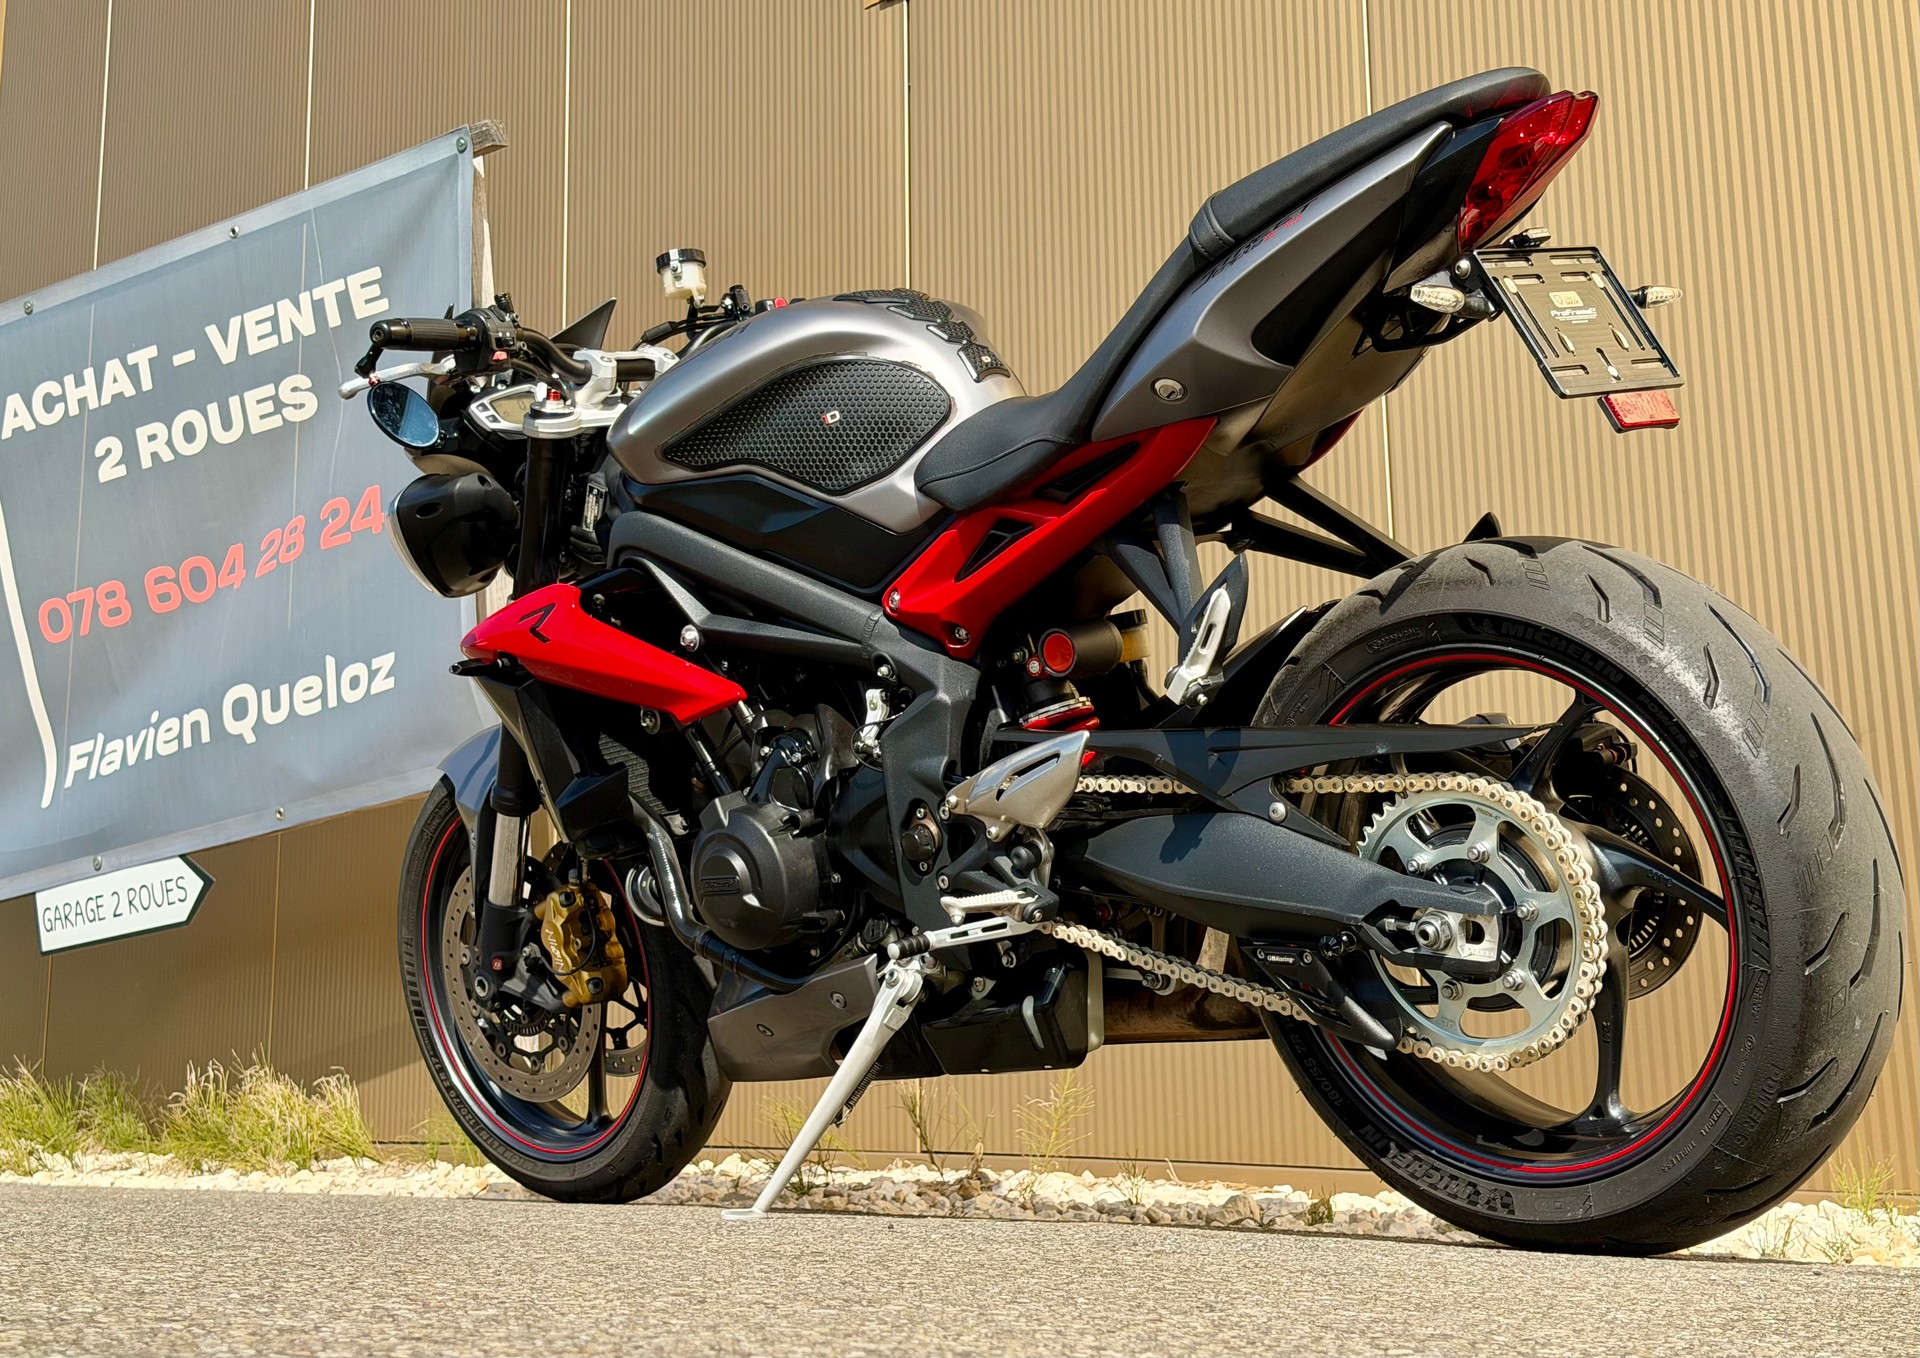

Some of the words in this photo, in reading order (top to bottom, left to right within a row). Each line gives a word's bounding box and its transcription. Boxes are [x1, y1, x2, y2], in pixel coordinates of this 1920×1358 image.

[1, 345, 158, 440] ACHAT
[204, 266, 389, 366] VENTE
[94, 436, 127, 483] 2
[135, 374, 319, 469] ROUES
[37, 579, 132, 644] 078
[144, 543, 245, 614] 604
[255, 515, 306, 578] 28
[319, 485, 385, 550] 24
[1500, 621, 1624, 684] MICHELIN
[1566, 611, 1636, 653] POWER
[64, 708, 211, 789] Flavien
[222, 651, 395, 744] Queloz
[1637, 693, 1688, 744] POWER
[42, 895, 106, 932] GARAGE
[111, 891, 124, 918] 2
[127, 876, 188, 914] ROUES
[1358, 1124, 1475, 1199] MICHELIN
